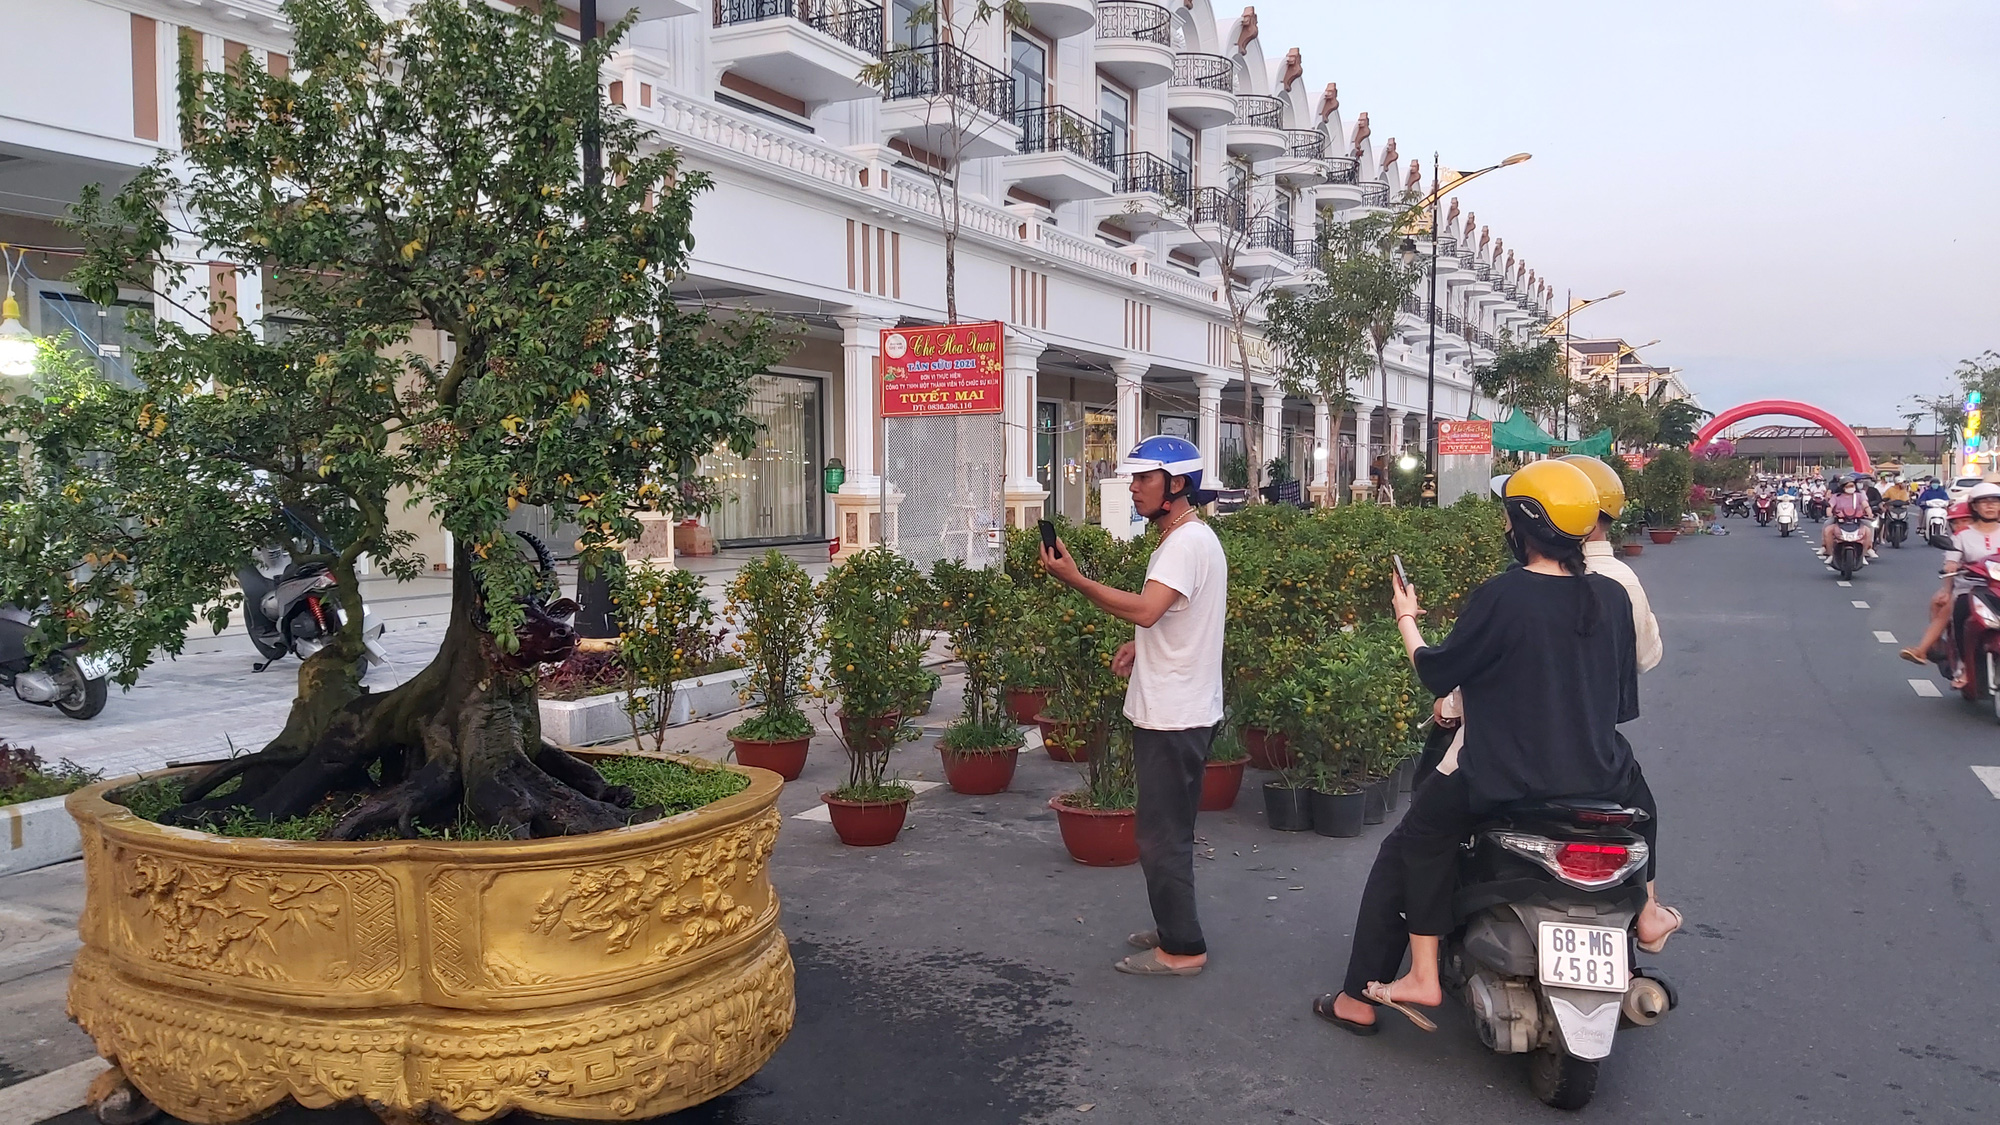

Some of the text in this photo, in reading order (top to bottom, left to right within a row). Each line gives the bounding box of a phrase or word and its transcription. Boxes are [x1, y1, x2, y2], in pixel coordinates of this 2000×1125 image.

[909, 335, 936, 360] Chợ
[936, 332, 964, 355] Hoa
[966, 331, 996, 354] Xuân
[954, 359, 976, 370] 2021
[899, 388, 985, 404] TUYẾT MAI
[1552, 928, 1613, 957] 68-M6
[1552, 956, 1614, 985] 4583
